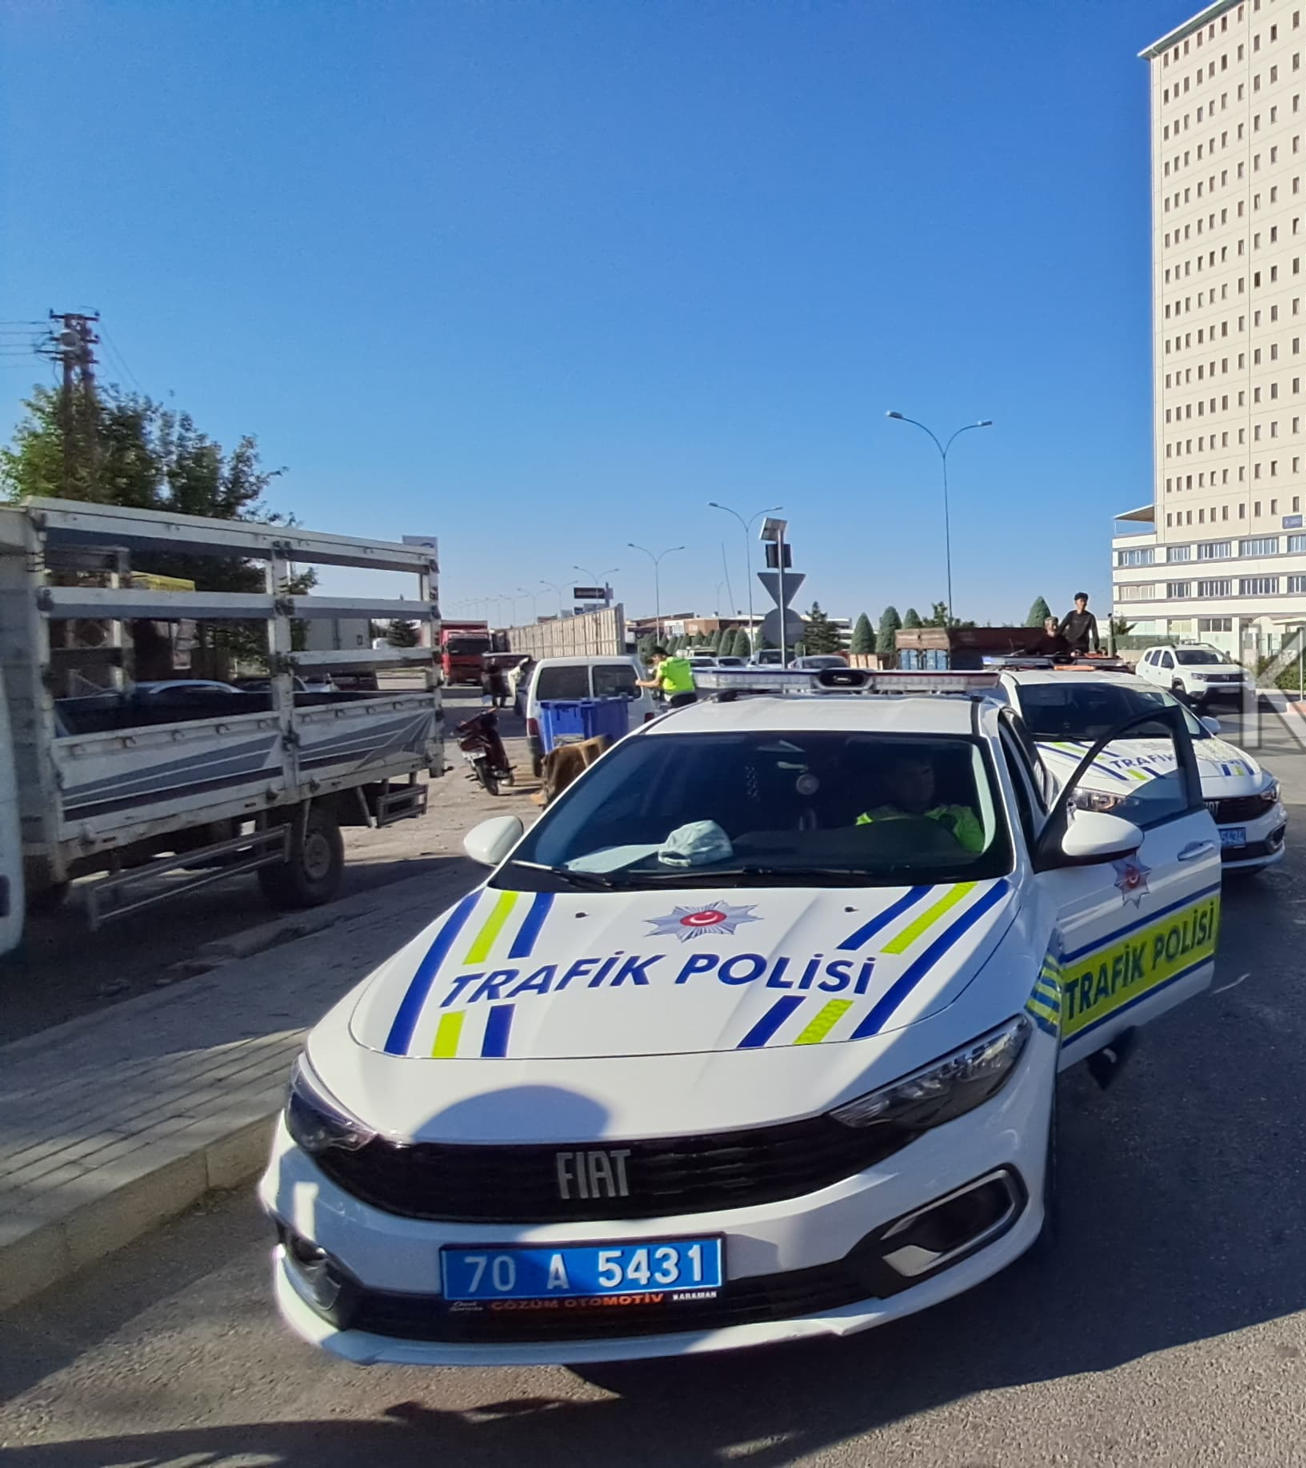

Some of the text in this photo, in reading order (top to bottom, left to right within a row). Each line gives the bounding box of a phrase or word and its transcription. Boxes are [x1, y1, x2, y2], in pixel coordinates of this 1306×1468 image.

[439, 951, 876, 1008] TRAFİK POLİSİ
[1064, 902, 1214, 1020] TRAFİK POLİSİ
[556, 1149, 632, 1199] FIAT
[464, 1244, 702, 1292] 70 A 5431
